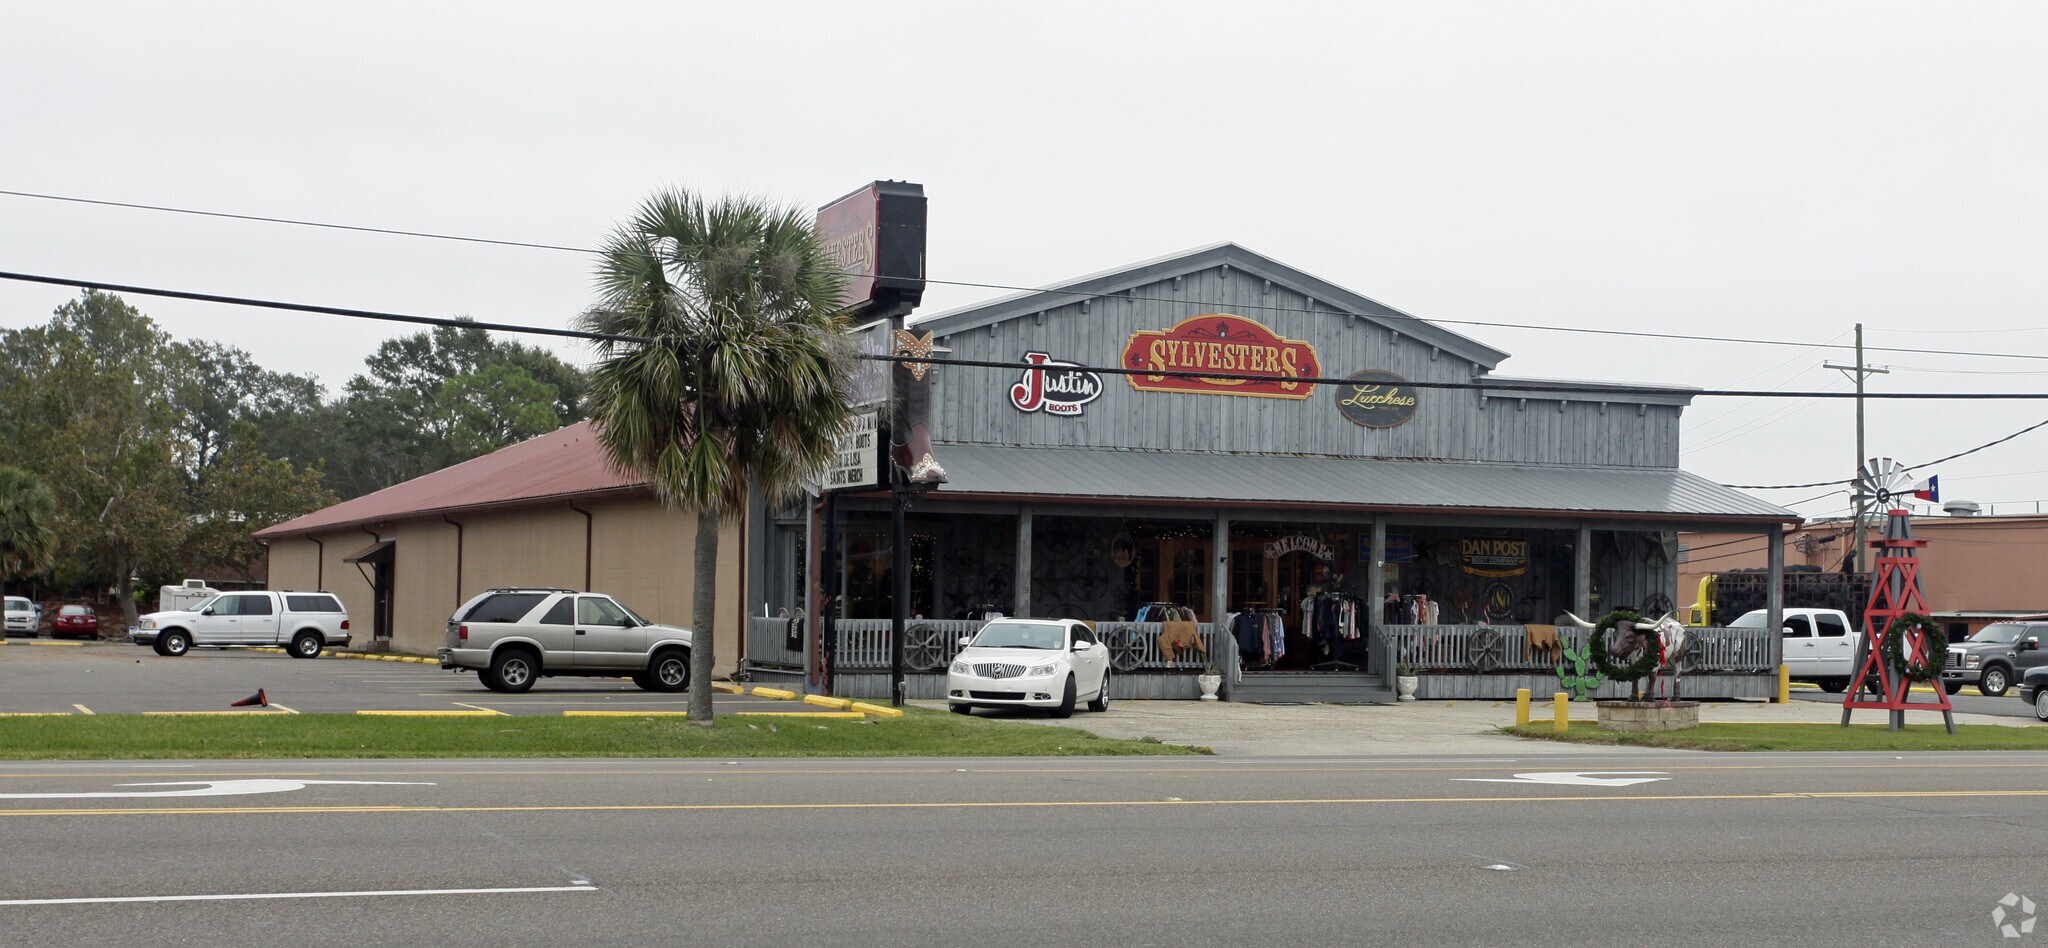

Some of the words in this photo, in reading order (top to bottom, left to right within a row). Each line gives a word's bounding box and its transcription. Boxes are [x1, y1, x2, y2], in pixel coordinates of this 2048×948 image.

[1147, 339, 1299, 391] SYLVESTERS
[1011, 352, 1095, 411] Justin
[1341, 384, 1415, 410] Lucchese
[1048, 403, 1079, 412] BOOTS
[856, 433, 871, 449] BOOTS
[830, 470, 846, 485] SAINTS
[847, 468, 864, 483] MERCH
[1272, 535, 1327, 560] WELCOME
[1462, 539, 1491, 555] DAN
[1493, 540, 1528, 557] POST
[1472, 556, 1488, 564] BOOT
[1489, 557, 1519, 565] COMPANY
